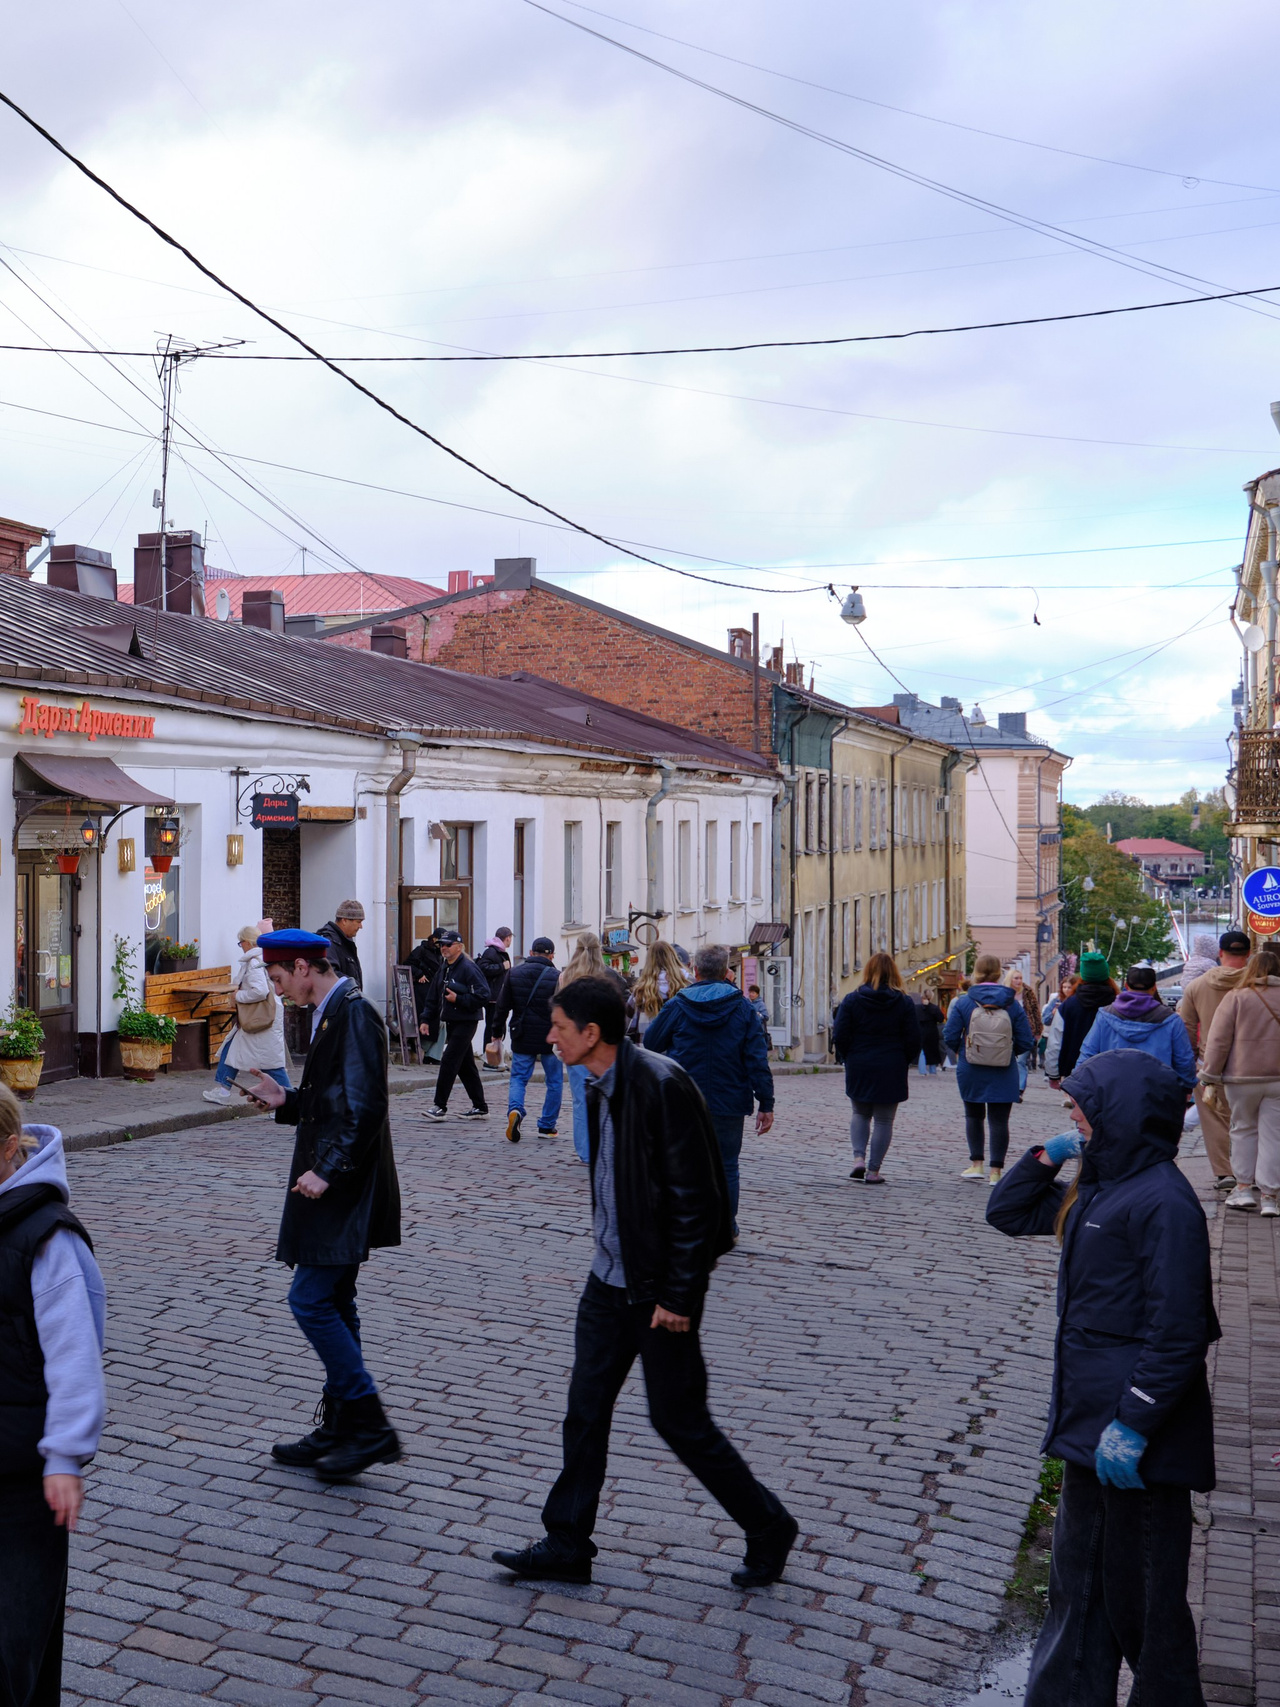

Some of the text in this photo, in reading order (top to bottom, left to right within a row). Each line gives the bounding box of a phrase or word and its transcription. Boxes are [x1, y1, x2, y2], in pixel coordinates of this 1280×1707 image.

[19, 696, 156, 742] Дары Армении
[262, 797, 288, 809] Дары
[255, 812, 295, 823] Армении
[1253, 893, 1280, 904] AURO
